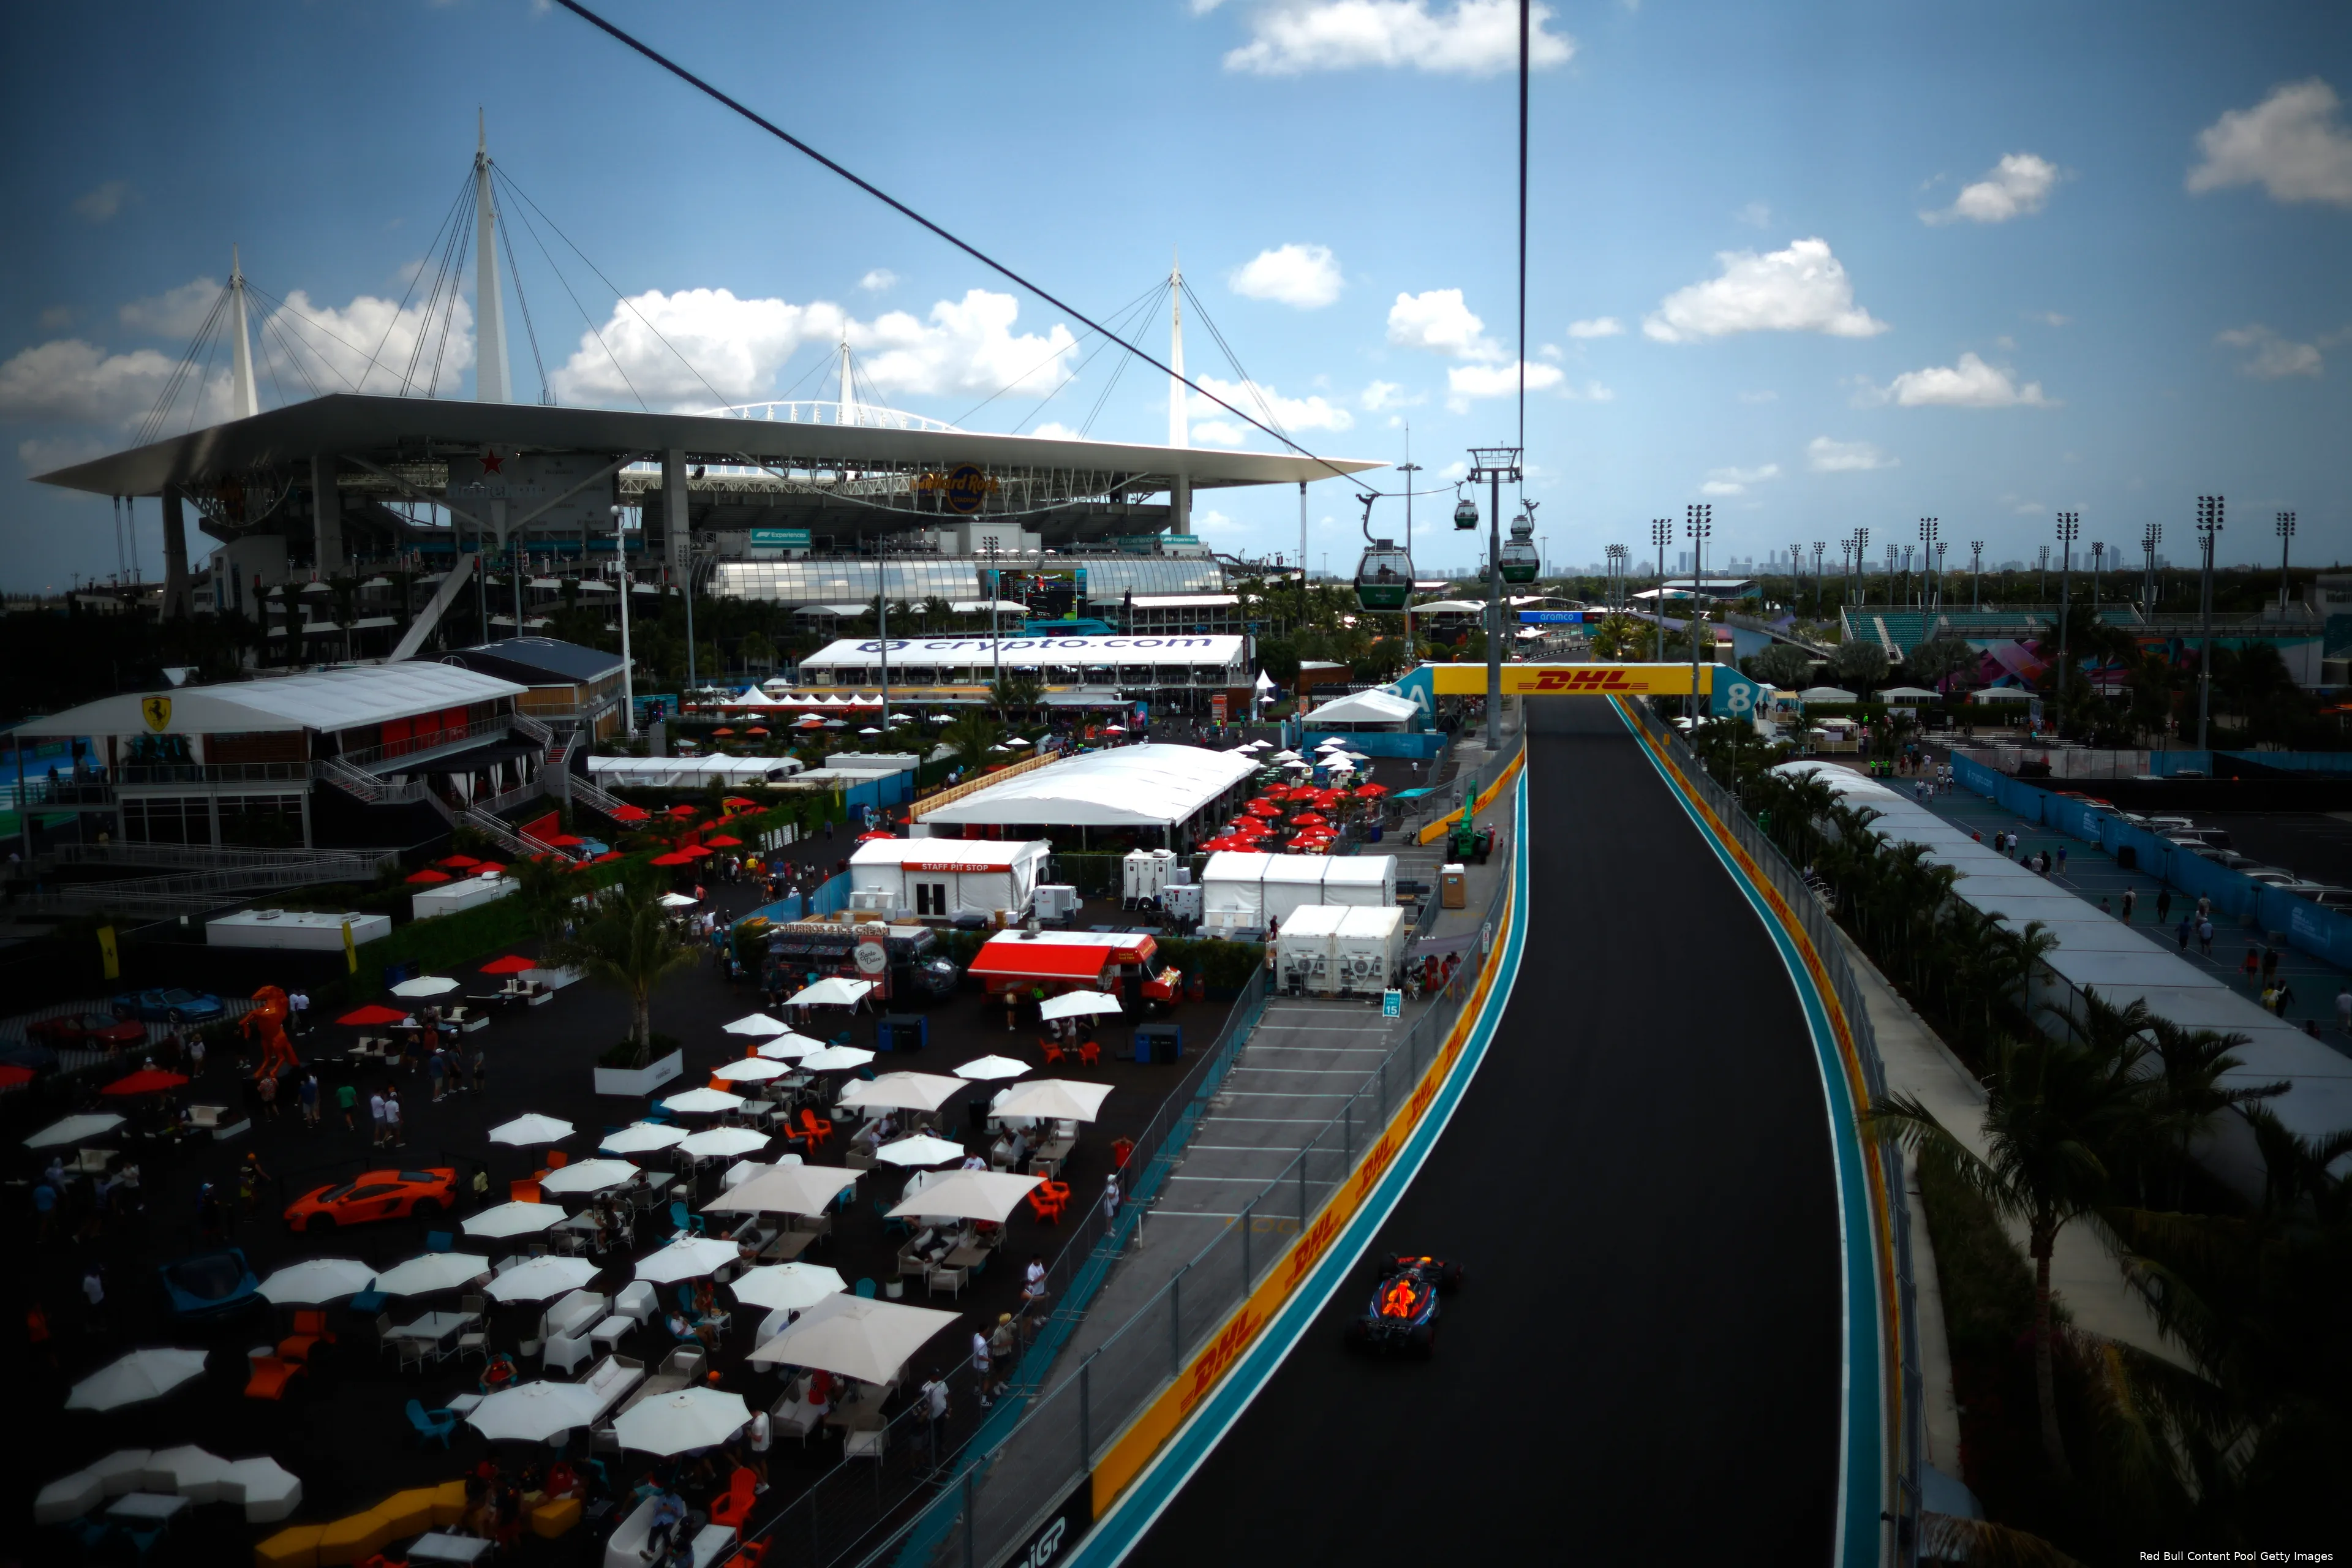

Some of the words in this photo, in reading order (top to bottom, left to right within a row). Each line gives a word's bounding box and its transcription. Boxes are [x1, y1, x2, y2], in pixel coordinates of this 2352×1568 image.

[968, 473, 999, 495] Rock
[924, 638, 1213, 652] crypto.com
[1533, 670, 1632, 690] DHL
[1768, 888, 1789, 923] DHL
[777, 924, 824, 934] CHURROS
[855, 927, 890, 935] CREAM
[859, 950, 876, 960] Santo
[865, 956, 883, 965] Dulce!
[1803, 938, 1822, 982] DHL
[1386, 1005, 1397, 1015] 15
[1834, 1005, 1852, 1064] DHL
[1411, 1076, 1433, 1120] DHL
[1361, 1134, 1391, 1192] DHL
[1294, 1209, 1336, 1280] DHL
[1193, 1308, 1256, 1400] DHL
